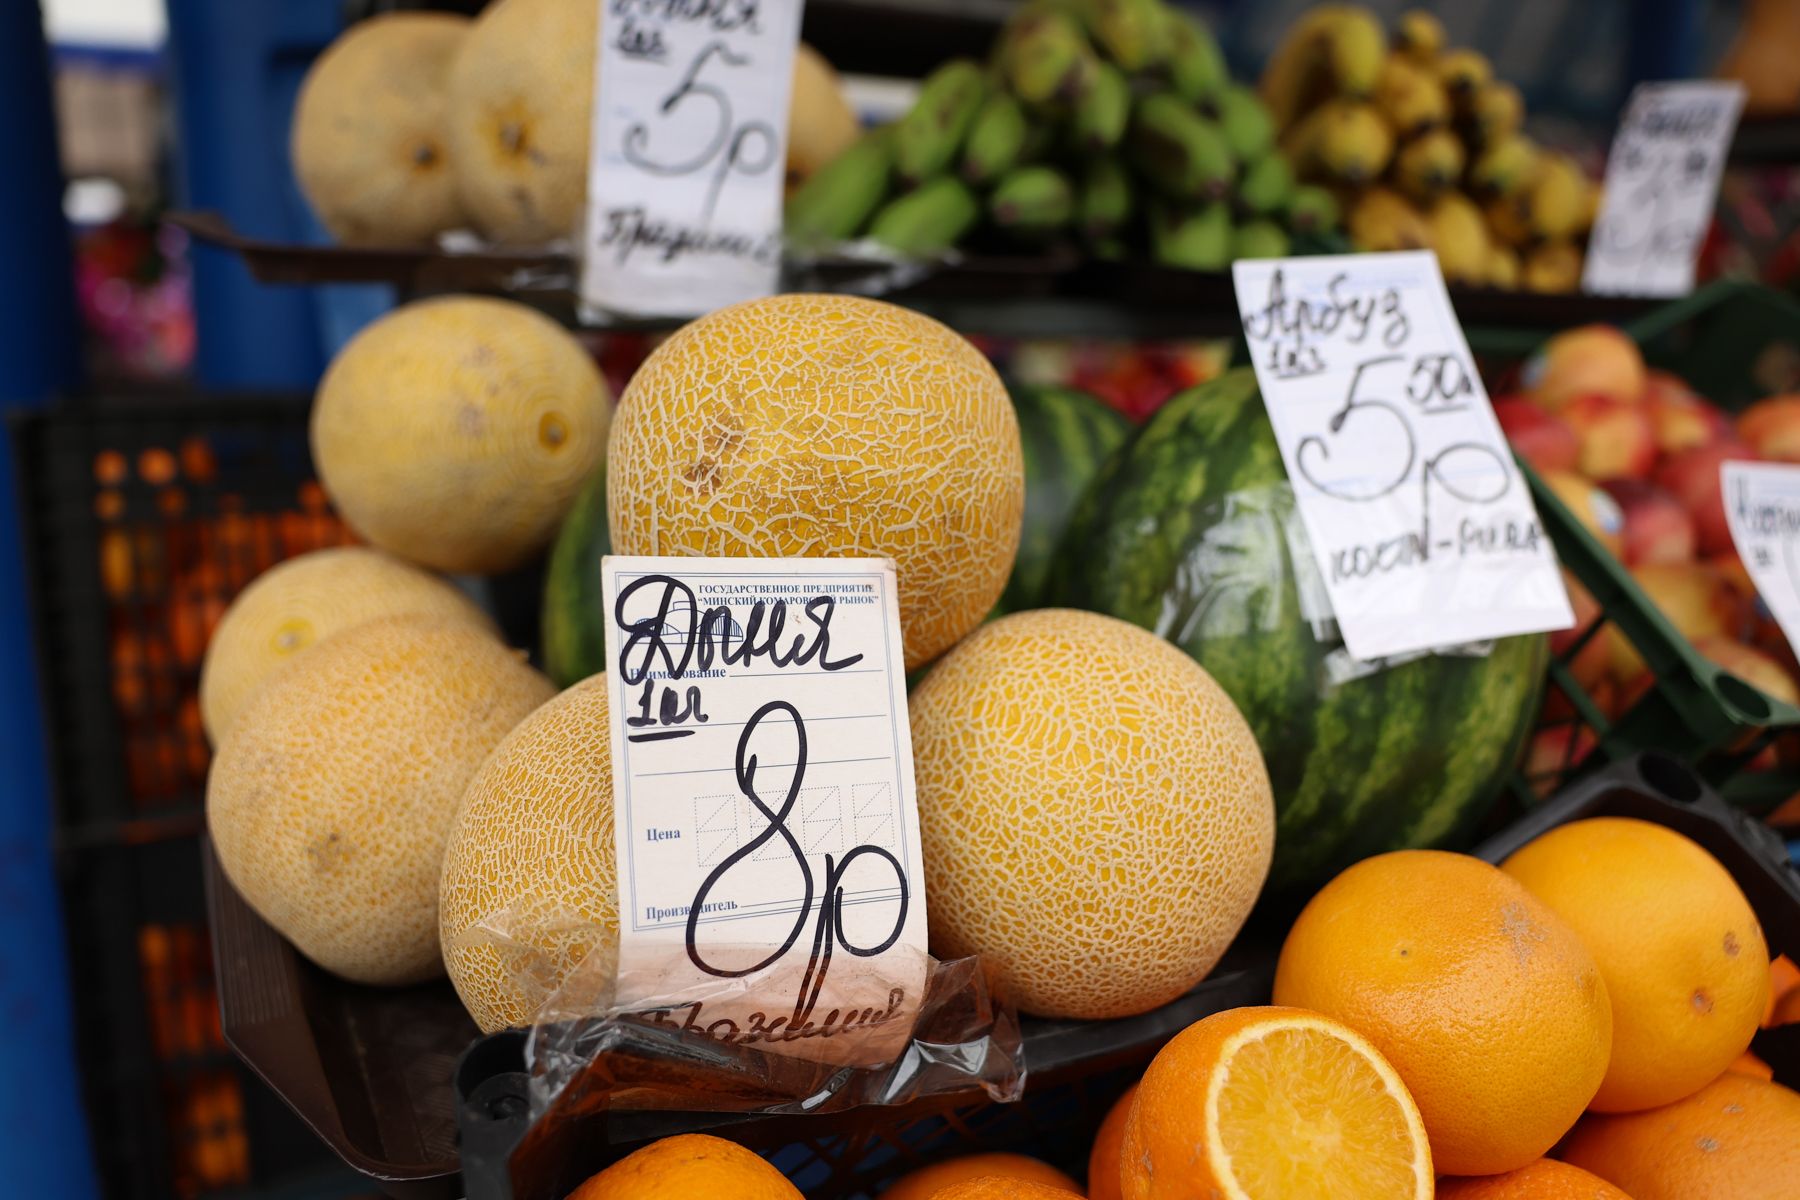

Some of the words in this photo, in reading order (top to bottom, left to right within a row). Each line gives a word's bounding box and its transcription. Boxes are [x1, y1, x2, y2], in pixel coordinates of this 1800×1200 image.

[1242, 266, 1411, 347] Арбуз
[698, 584, 801, 595] ГОСУДАРСТВЕННОЕ
[803, 583, 875, 594] ПРЕДПРИЯТИЕ
[615, 574, 864, 686] Дыня
[630, 667, 727, 681] Нимеование
[646, 828, 681, 842] Цена
[646, 900, 738, 920] Произвдитель
